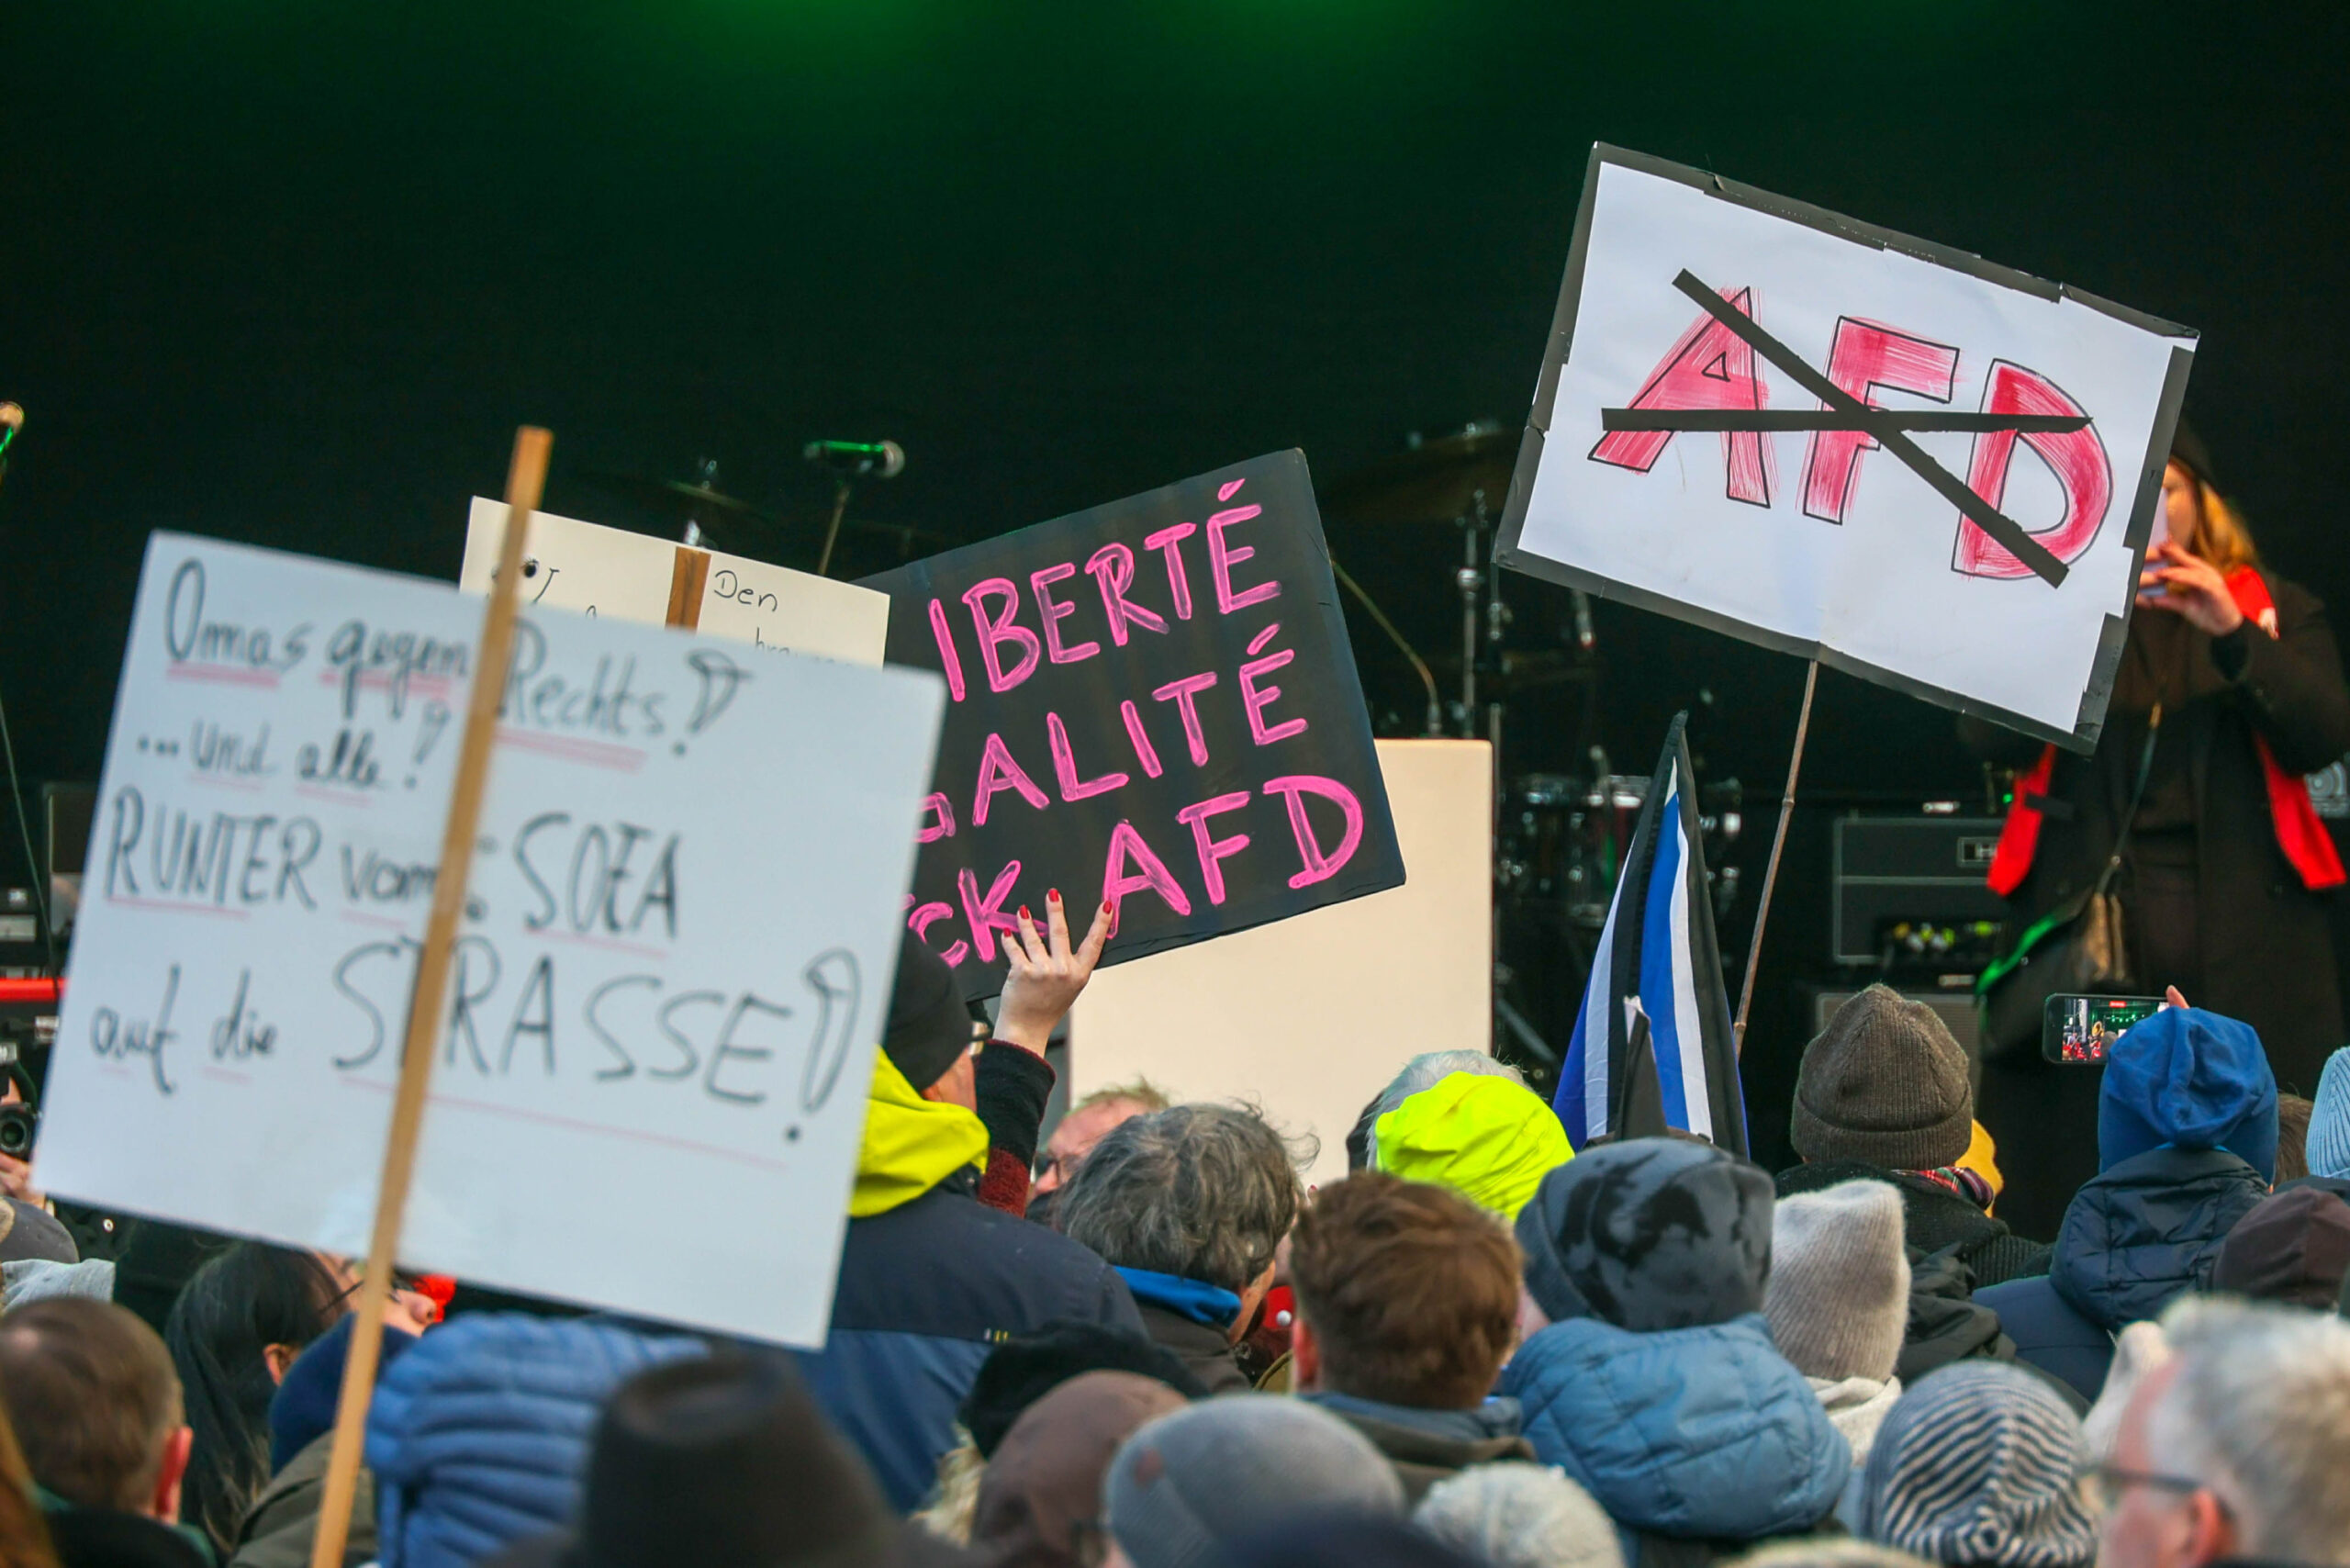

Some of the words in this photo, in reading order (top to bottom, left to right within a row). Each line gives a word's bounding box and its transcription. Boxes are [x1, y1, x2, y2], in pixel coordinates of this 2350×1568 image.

[1586, 284, 2114, 581] AFD
[162, 555, 316, 676] Omas
[324, 619, 474, 722] gegen
[713, 569, 778, 613] Den
[928, 476, 1283, 703] IBERTÉ
[912, 621, 1310, 844] ALITÉ
[103, 784, 319, 913] RUNTER
[511, 809, 684, 942] SOFA
[901, 858, 1050, 969] CK
[1102, 773, 1366, 941] AFD
[90, 960, 182, 1096] auf
[210, 966, 279, 1063] die
